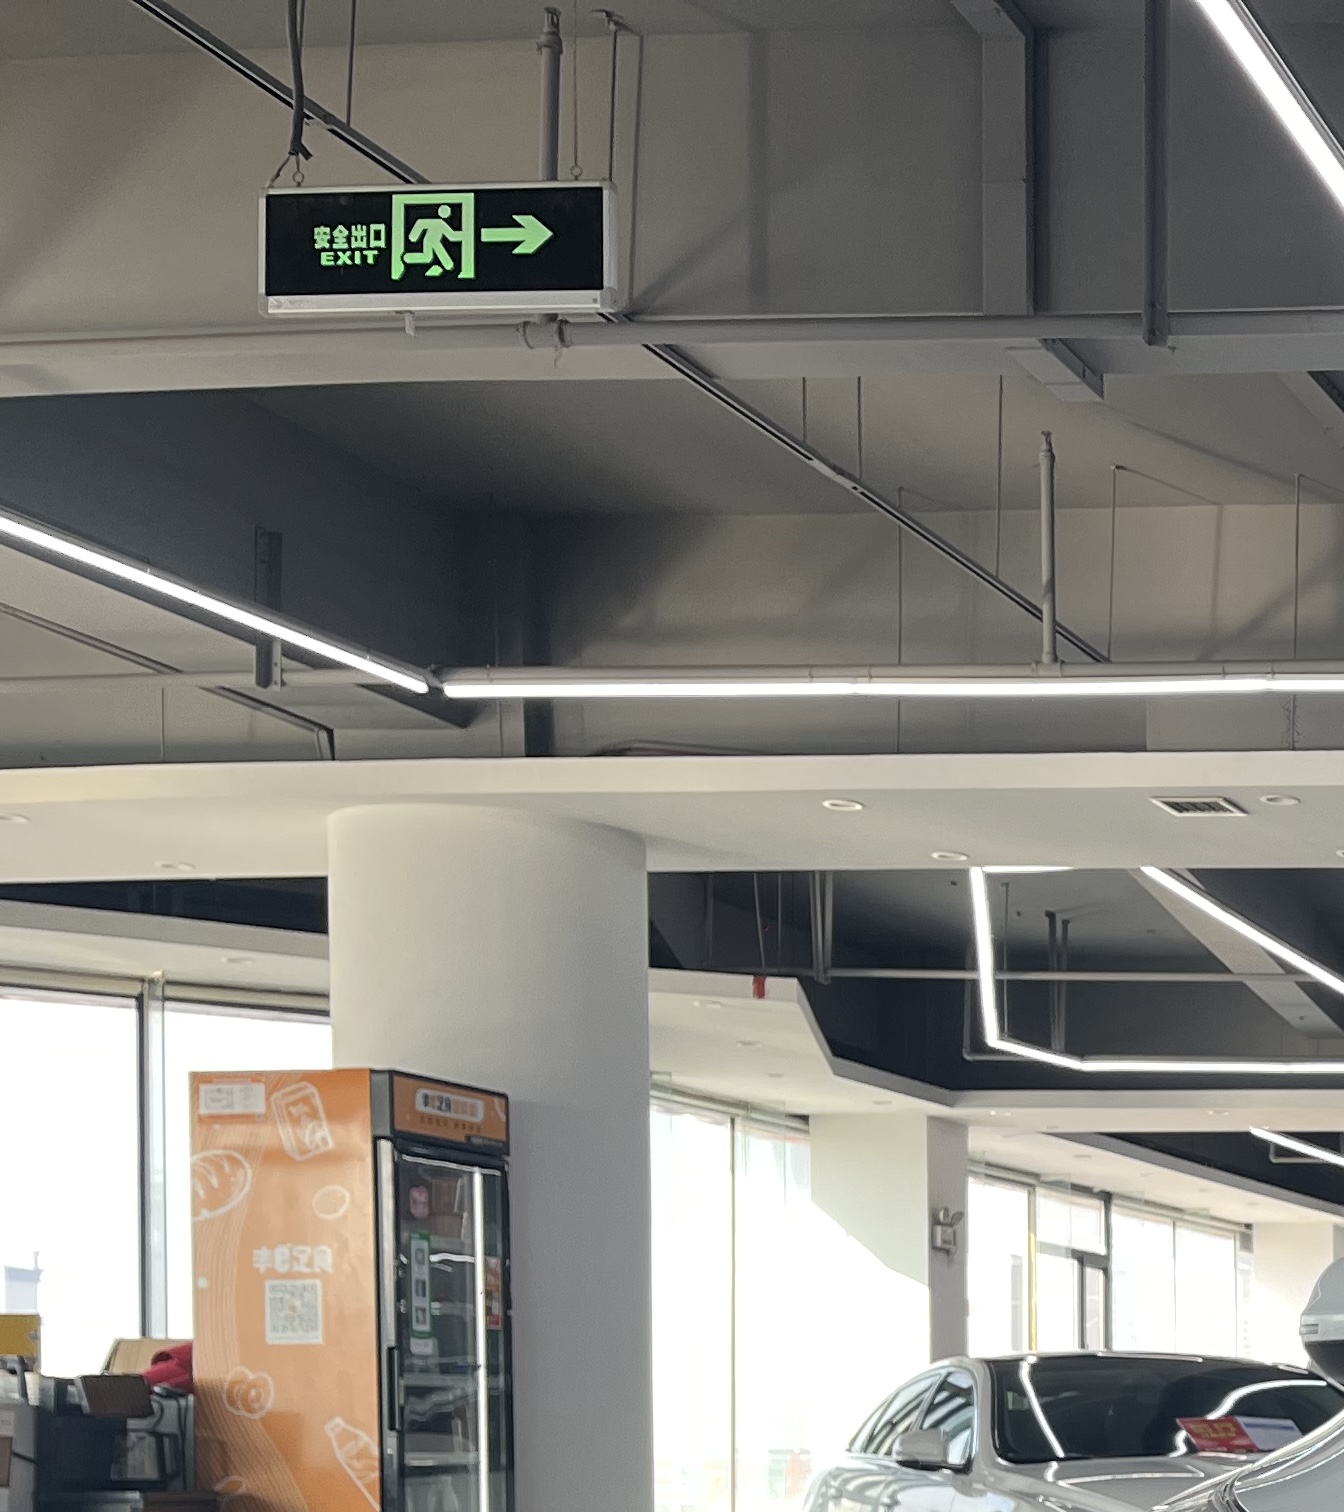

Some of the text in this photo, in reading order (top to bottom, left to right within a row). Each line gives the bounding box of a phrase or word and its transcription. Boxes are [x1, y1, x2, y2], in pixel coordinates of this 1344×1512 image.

[313, 223, 387, 250] 安全出口
[320, 250, 379, 267] EXIT
